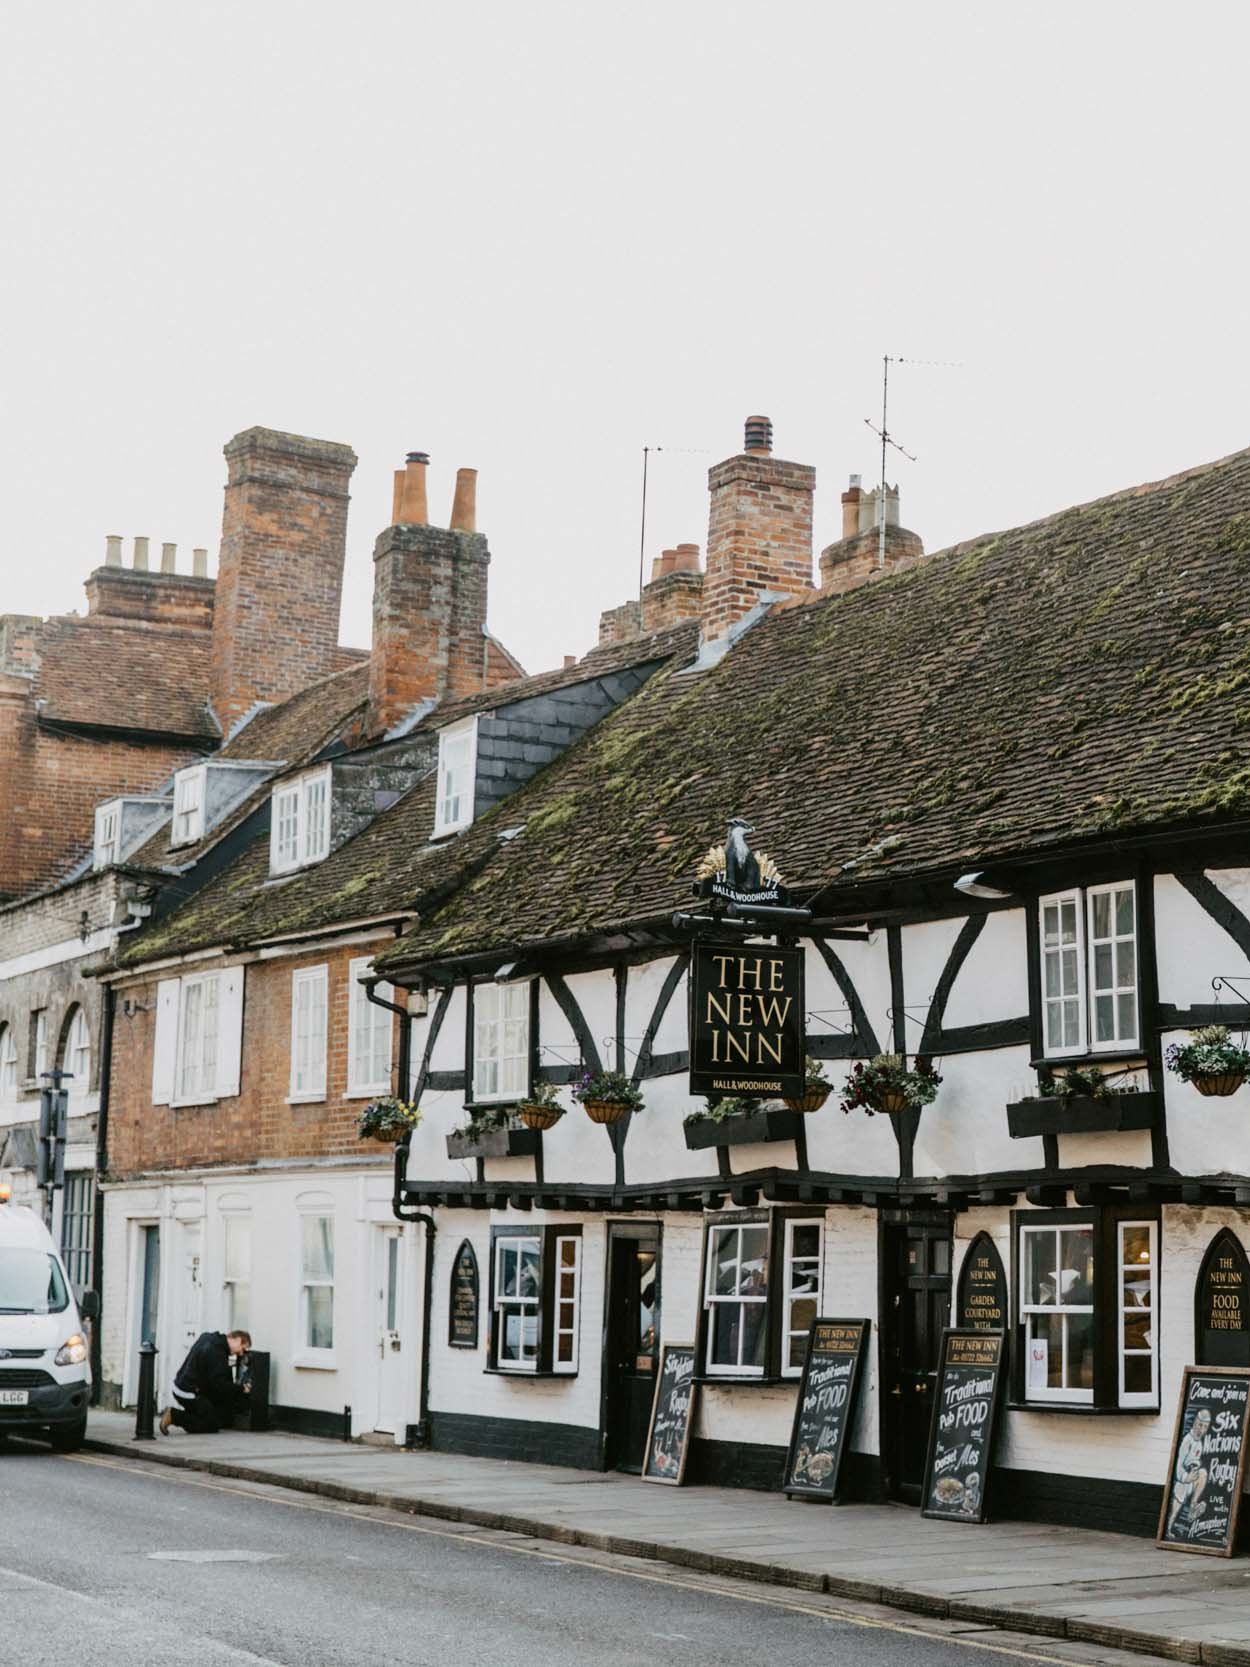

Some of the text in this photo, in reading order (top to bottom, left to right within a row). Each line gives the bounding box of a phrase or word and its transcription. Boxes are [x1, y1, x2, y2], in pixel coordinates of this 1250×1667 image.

[715, 871, 727, 883] 17
[763, 875, 778, 890] 77
[712, 955, 785, 992] THE
[704, 991, 793, 1028] NEW
[711, 1029, 784, 1065] INN
[977, 1258, 989, 1268] THE
[1219, 1258, 1233, 1269] THE
[970, 1271, 997, 1280] NEW INN
[1210, 1272, 1242, 1283] NEW INN
[970, 1296, 995, 1305] GARDEN
[1213, 1295, 1239, 1309] FOOD
[964, 1308, 1000, 1319] COURTYARD
[1211, 1309, 1241, 1319] AVAILABLE
[1210, 1319, 1242, 1330] EVERY DAY
[952, 1340, 998, 1351] THE NEW INN
[809, 1359, 853, 1386] Traditional
[945, 1372, 995, 1405] Traditional
[1211, 1385, 1226, 1400] and
[1223, 1384, 1239, 1404] join
[1238, 1390, 1247, 1402] us
[816, 1384, 847, 1414] FOOD
[955, 1401, 988, 1429] FOOD
[1211, 1411, 1240, 1432] Six
[1203, 1432, 1242, 1455] Nations
[1208, 1458, 1237, 1492] Rugby
[1209, 1495, 1224, 1504] LIVE
